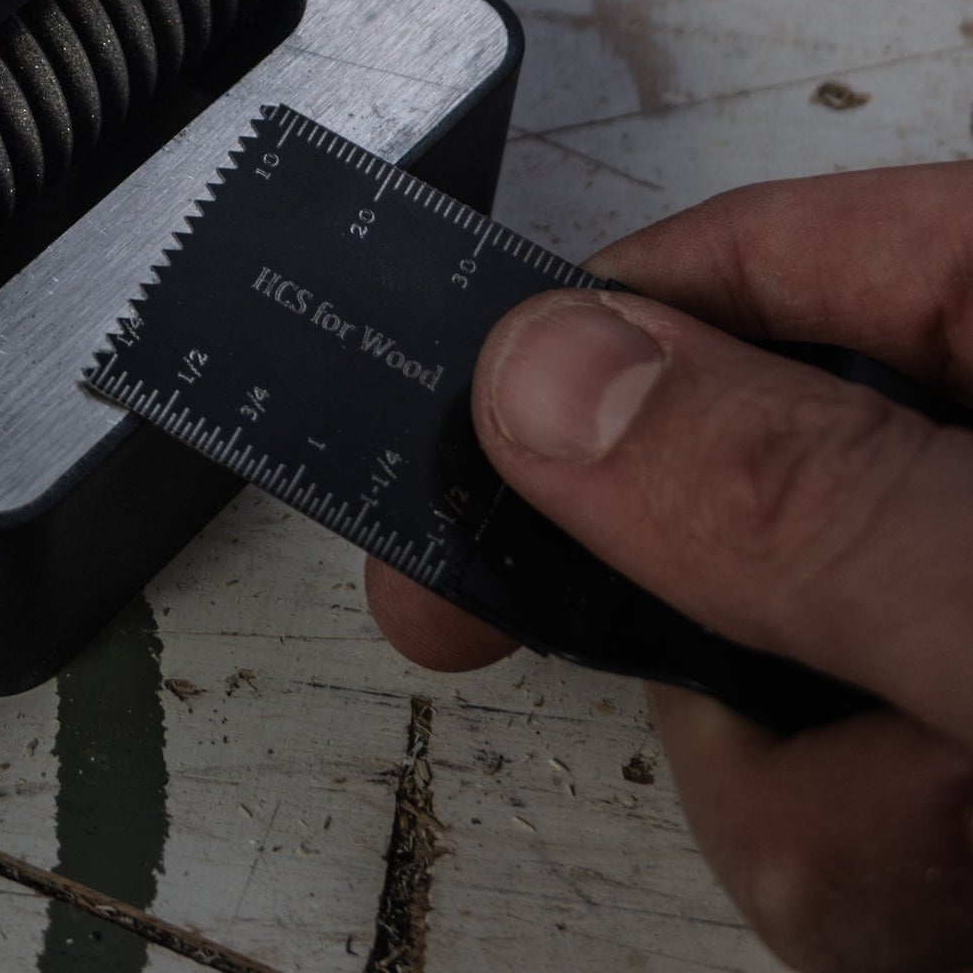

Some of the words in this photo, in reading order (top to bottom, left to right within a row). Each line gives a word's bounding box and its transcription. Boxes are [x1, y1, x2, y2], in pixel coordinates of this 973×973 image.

[254, 152, 280, 181] 10
[350, 208, 377, 239] 20
[451, 258, 477, 290] 30
[251, 265, 314, 315] HCS
[309, 301, 357, 338] for
[361, 324, 445, 393] Wood
[177, 348, 209, 385] 1/2
[239, 385, 270, 423] 3/4
[307, 435, 326, 451] 1
[360, 448, 403, 507] 1-1/4
[427, 484, 470, 546] 1-1/2
